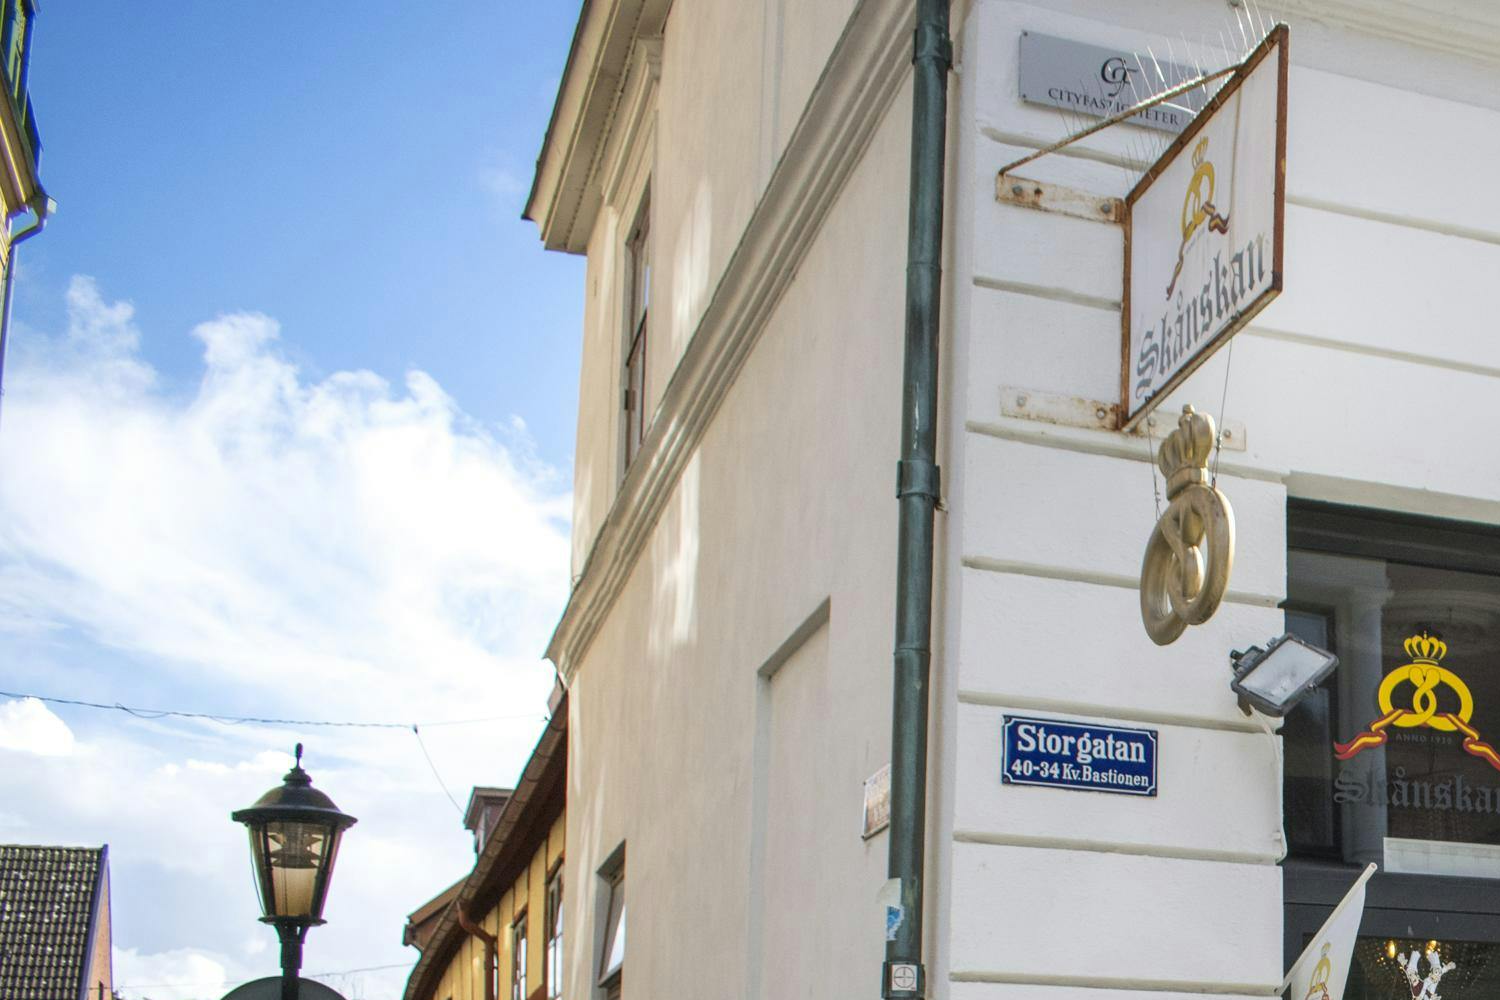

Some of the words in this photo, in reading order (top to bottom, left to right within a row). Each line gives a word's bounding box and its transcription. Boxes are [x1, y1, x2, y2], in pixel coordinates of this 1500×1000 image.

[1136, 232, 1265, 399] Skånskan
[1017, 724, 1146, 764] Storgatan
[1011, 759, 1059, 779] 40-34
